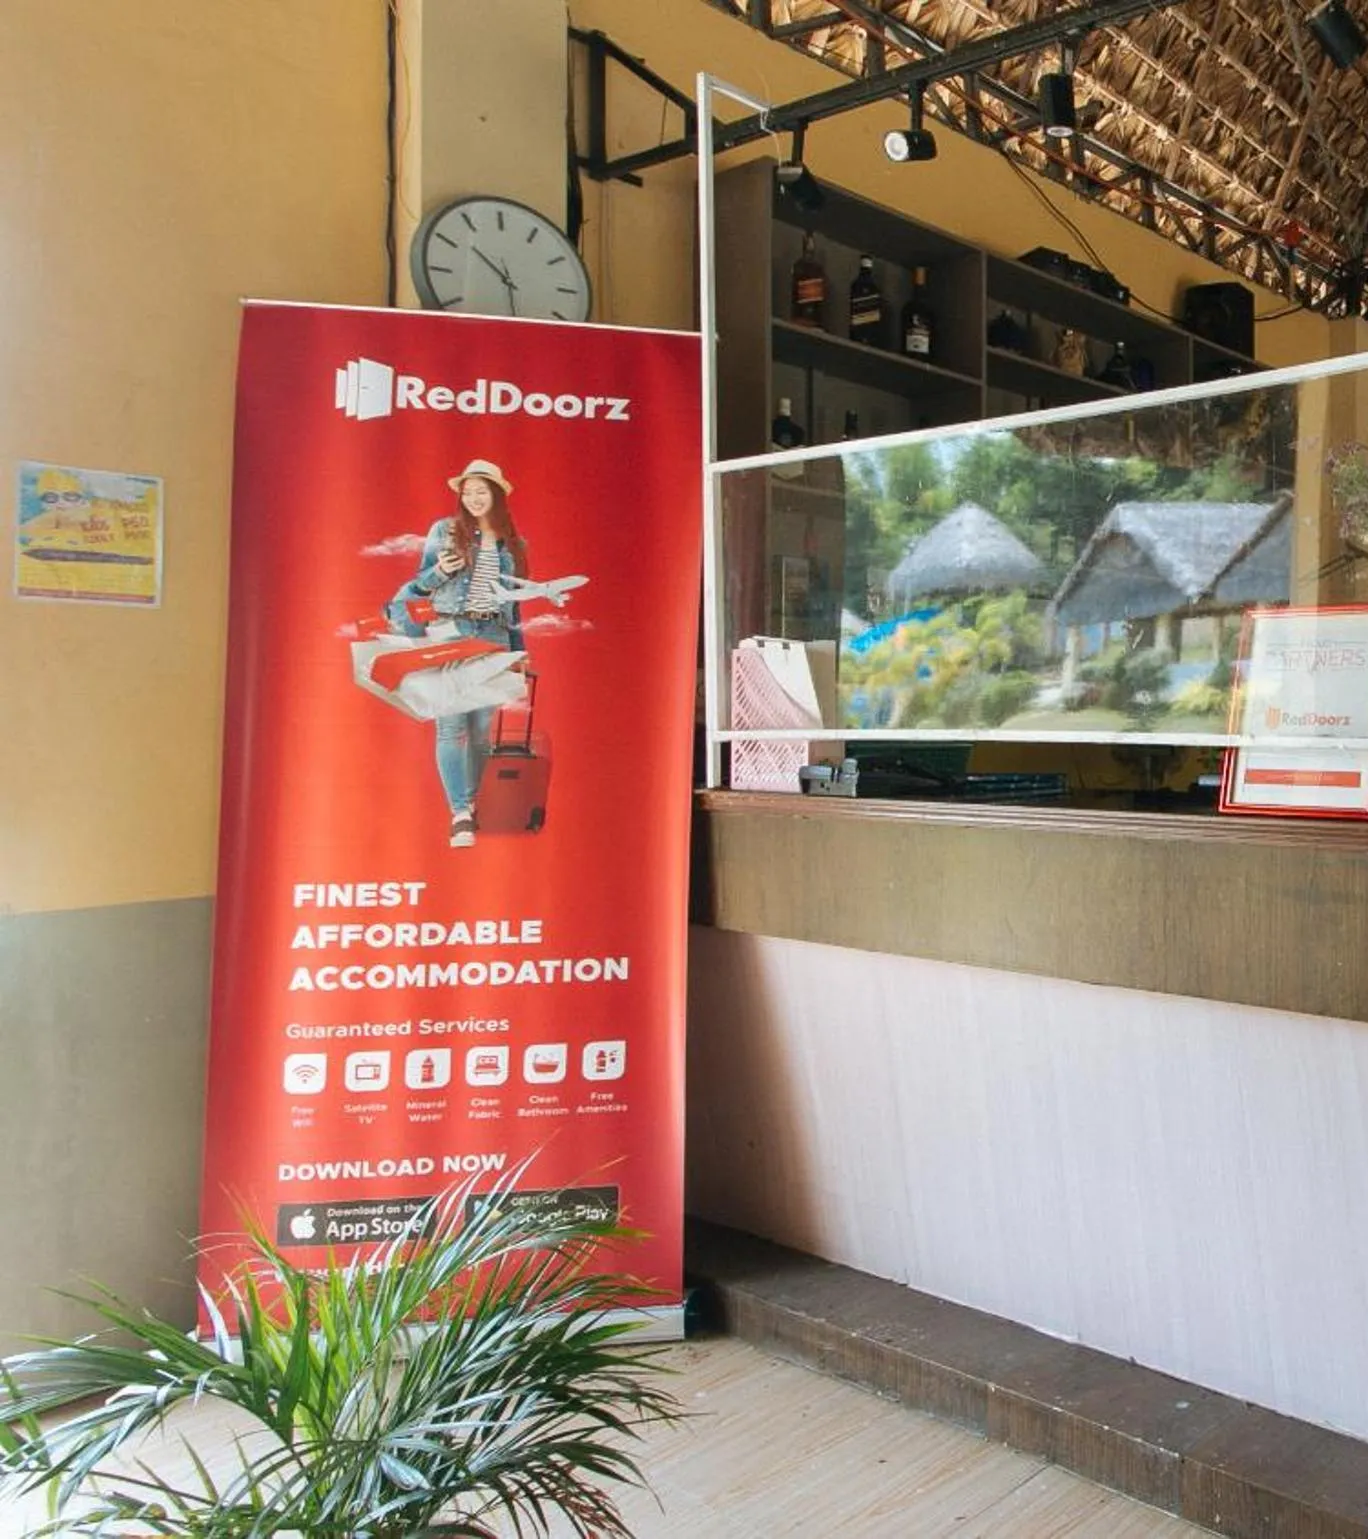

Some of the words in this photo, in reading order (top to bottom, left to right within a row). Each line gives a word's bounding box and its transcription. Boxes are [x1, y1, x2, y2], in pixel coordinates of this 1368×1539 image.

[396, 375, 631, 421] RedDoorz
[1282, 712, 1351, 727] RedDoorz
[293, 881, 427, 908] FINEST
[291, 920, 543, 949] AFFORDABLE
[289, 957, 629, 992] ACCOMMODATION
[286, 1020, 412, 1039] Guaranteed
[419, 1017, 510, 1035] Services
[406, 1098, 446, 1110] Mineral
[590, 1092, 614, 1101] Free
[409, 1113, 443, 1123] Water
[576, 1104, 628, 1114] Amenities
[278, 1157, 433, 1182] DOWNLOAD
[442, 1153, 507, 1174] NOW
[327, 1205, 384, 1217] Download
[386, 1206, 401, 1214] on
[326, 1220, 368, 1240] App
[371, 1217, 422, 1236] Store
